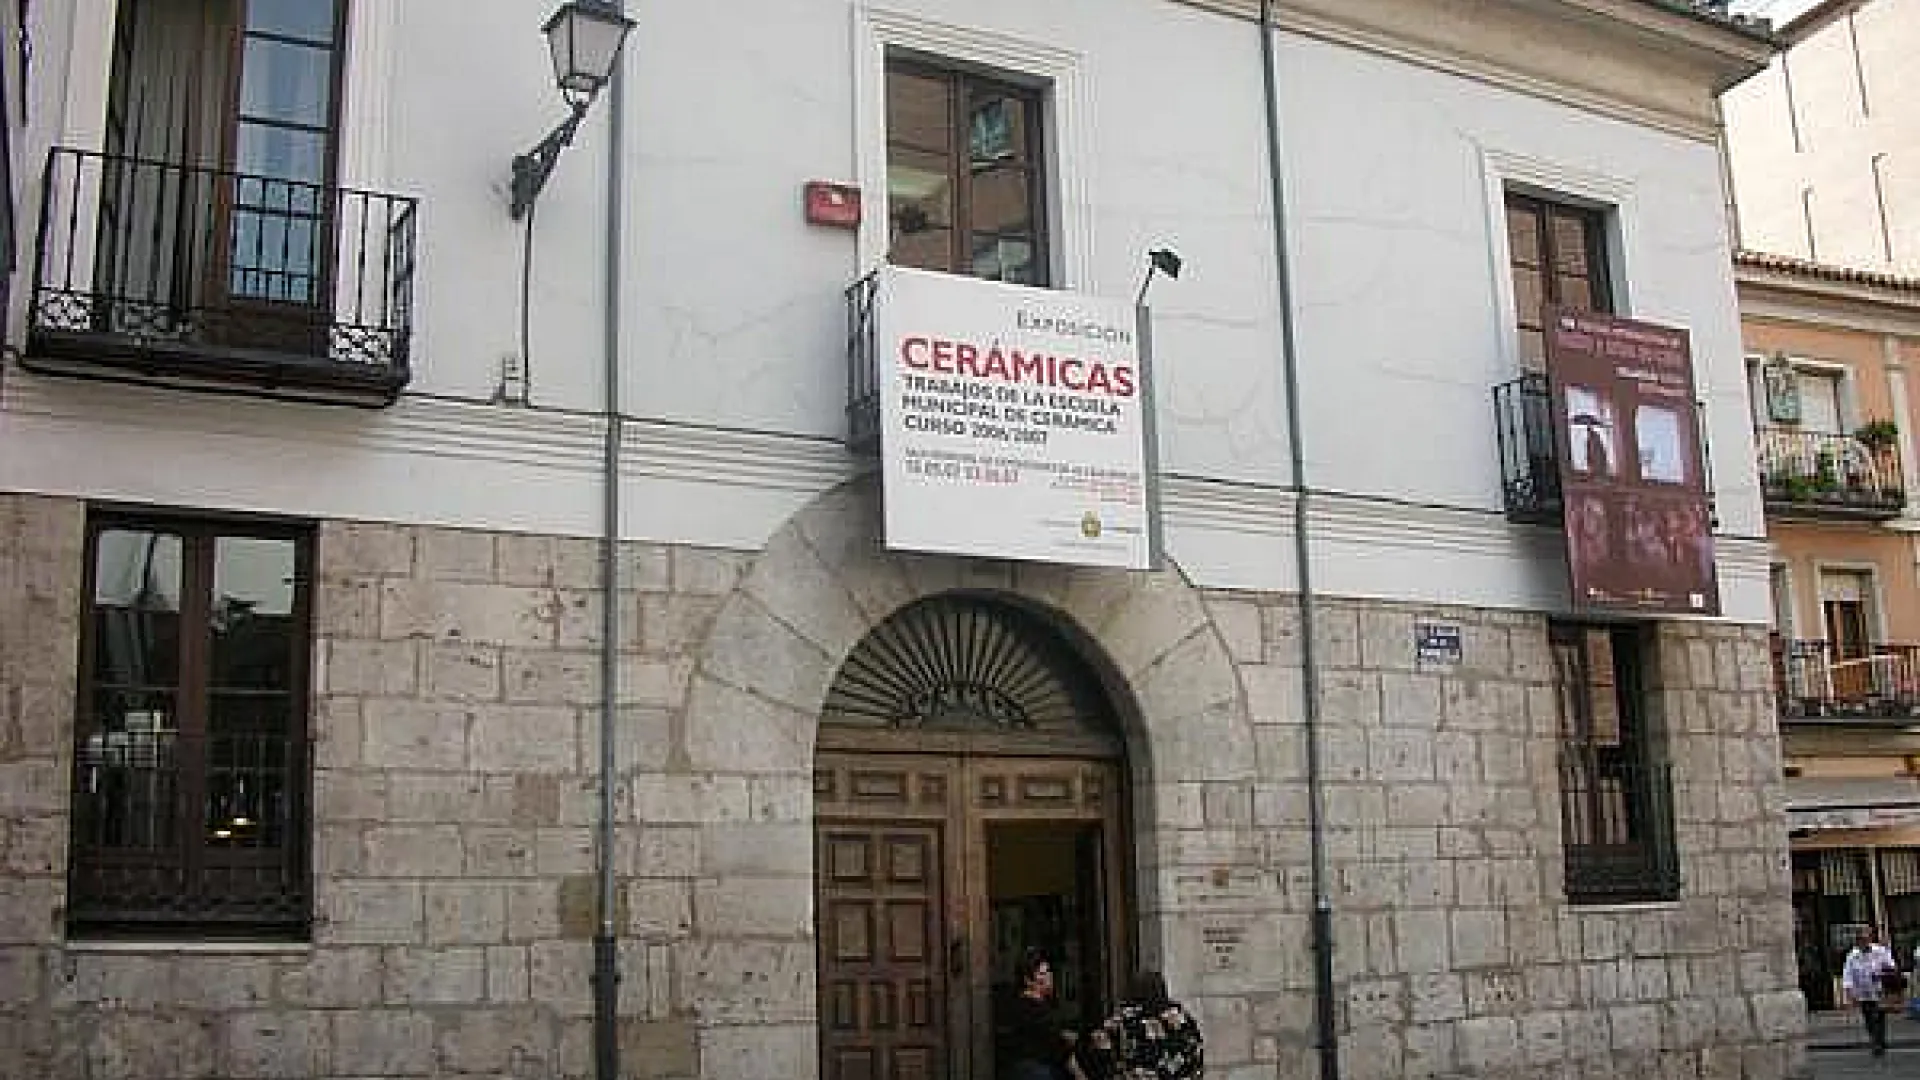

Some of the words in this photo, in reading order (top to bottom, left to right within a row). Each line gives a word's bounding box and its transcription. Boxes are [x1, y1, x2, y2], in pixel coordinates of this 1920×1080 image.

[901, 337, 1134, 396] CERÁMICAS
[902, 395, 998, 419] MUNICIPAL
[1004, 408, 1026, 422] DE
[905, 376, 993, 400] TRABAJOS
[996, 386, 1019, 402] DE
[1023, 392, 1044, 406] LA
[1049, 394, 1121, 416] ESCUELA
[905, 414, 967, 435] CURSO
